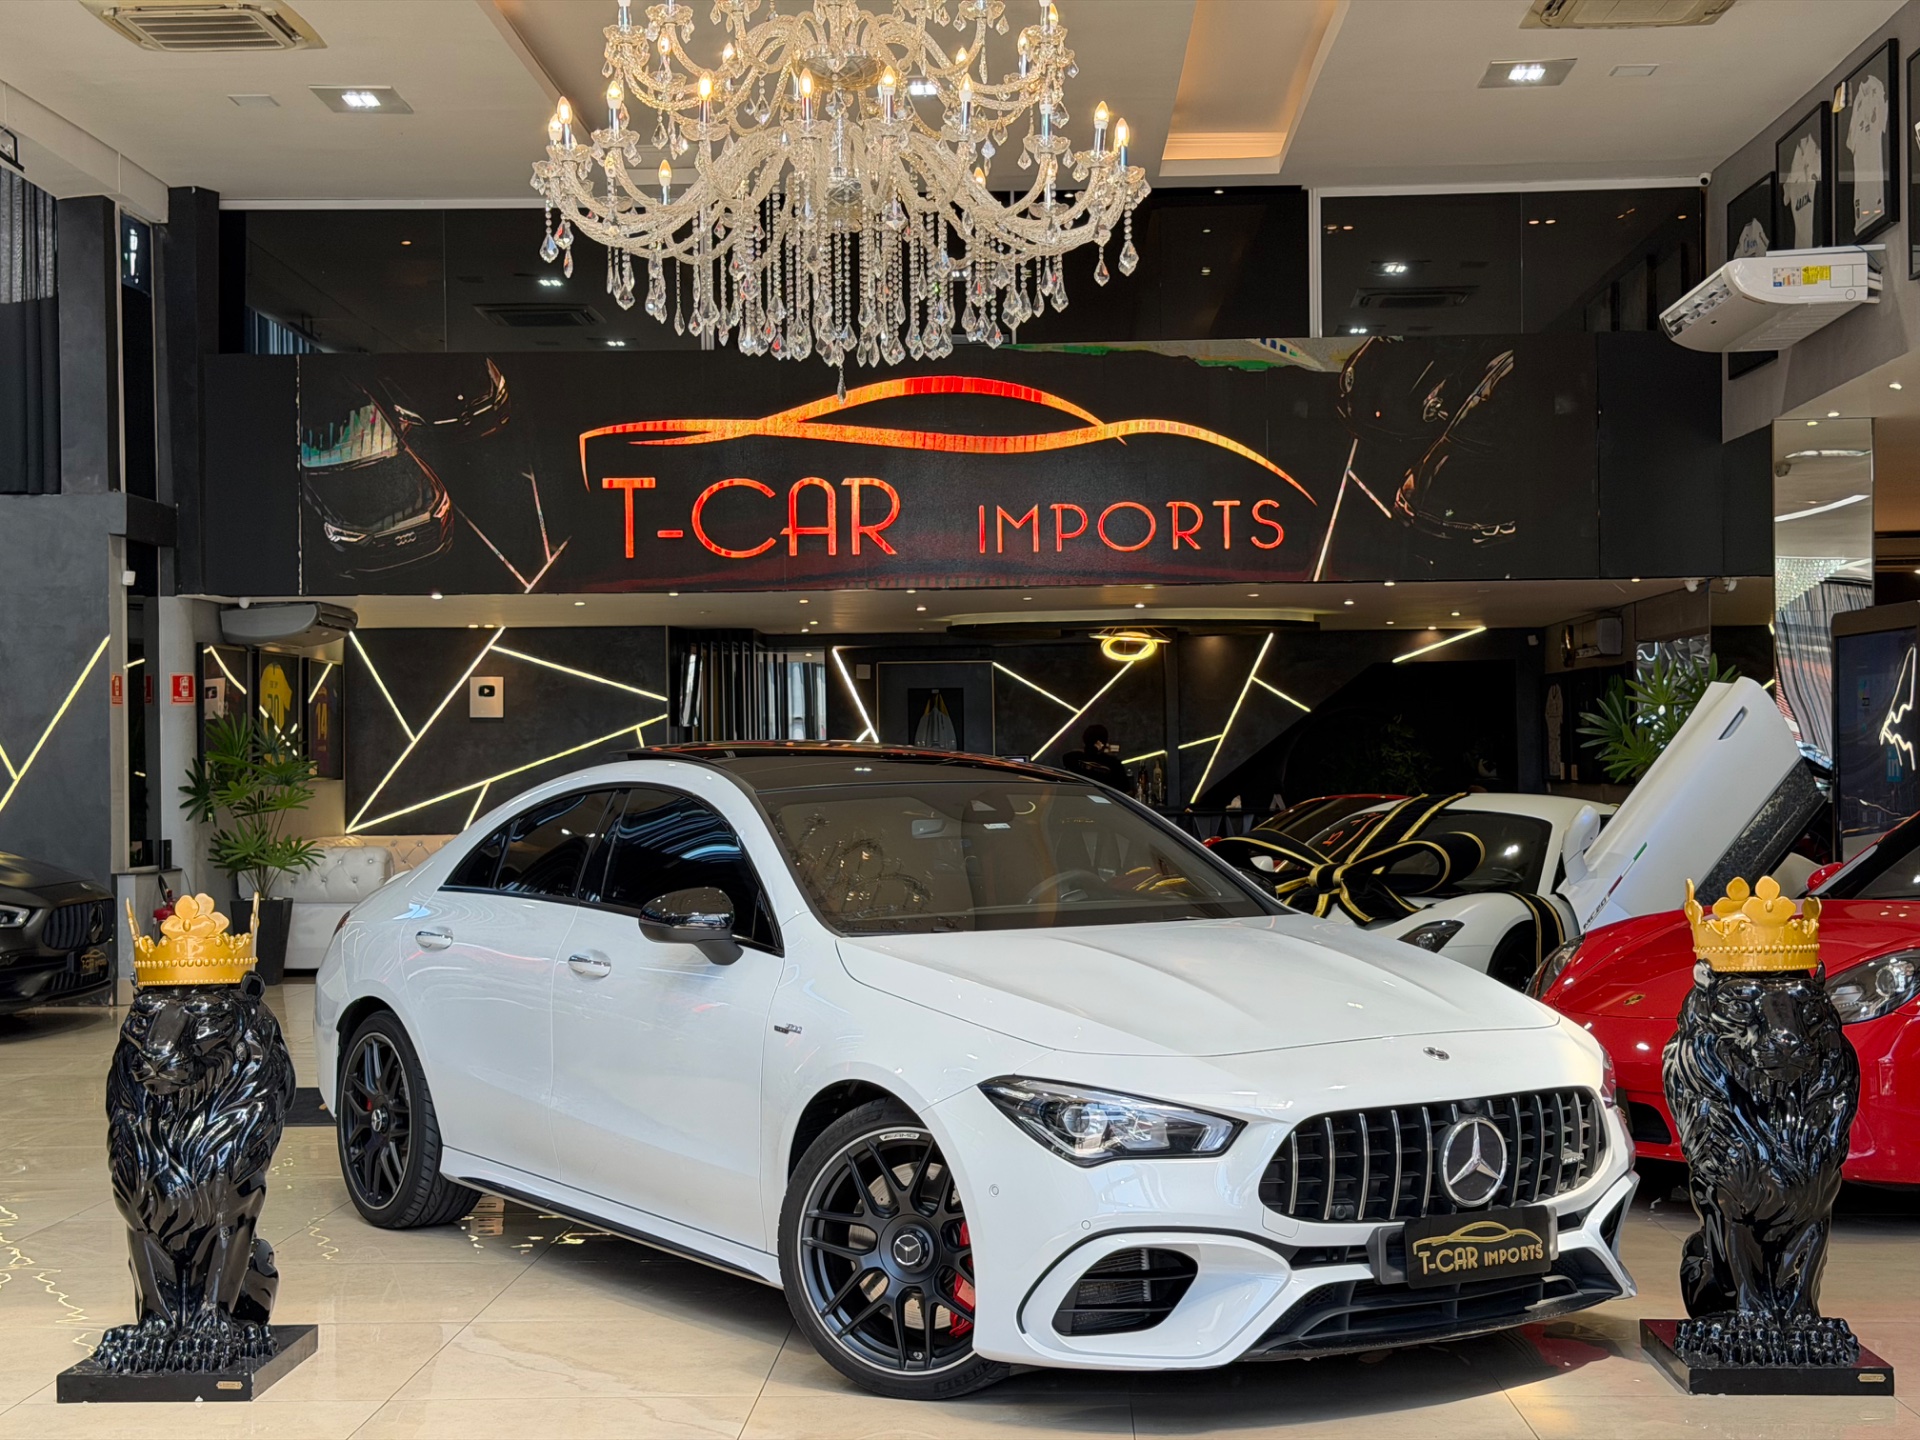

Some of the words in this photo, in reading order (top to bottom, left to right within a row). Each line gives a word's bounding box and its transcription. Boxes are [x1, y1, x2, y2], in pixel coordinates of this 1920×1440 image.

[602, 476, 900, 559] T-CAR
[979, 499, 1285, 553] IMPORTS
[1418, 1246, 1479, 1275] T-CAR
[1484, 1243, 1543, 1267] IMPORTS
